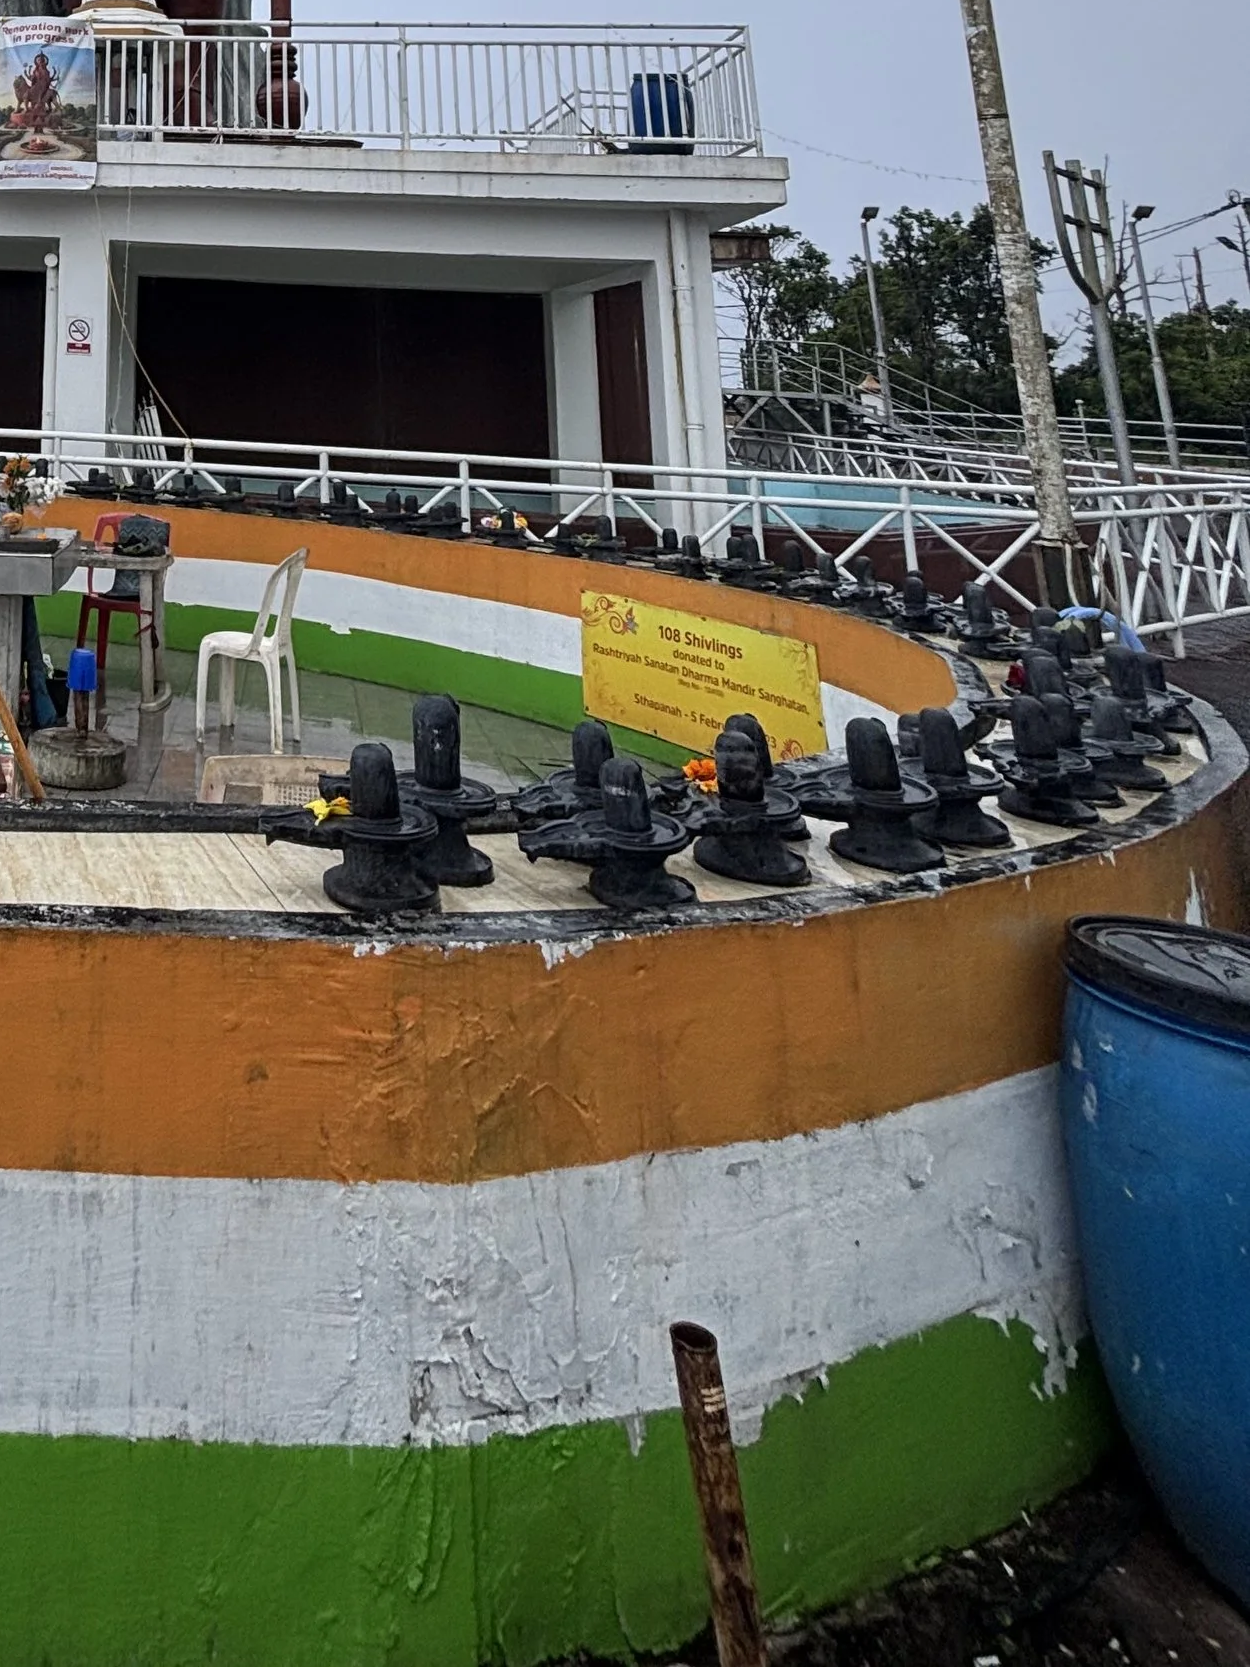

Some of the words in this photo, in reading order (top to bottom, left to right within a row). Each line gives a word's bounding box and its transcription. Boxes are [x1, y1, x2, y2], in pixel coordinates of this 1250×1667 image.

[2, 22, 62, 35] Renovation
[13, 34, 22, 43] in
[25, 33, 75, 44] progress
[659, 625, 681, 643] 108
[685, 631, 743, 659] Shivlings
[593, 642, 642, 663] Rashtriyah
[644, 655, 679, 675] Sanatan
[681, 665, 719, 686] Dharma
[721, 676, 756, 697] Mandir
[673, 649, 712, 667] donated
[714, 658, 725, 671] to
[633, 692, 682, 718] Sthapanah
[690, 711, 698, 723] 5
